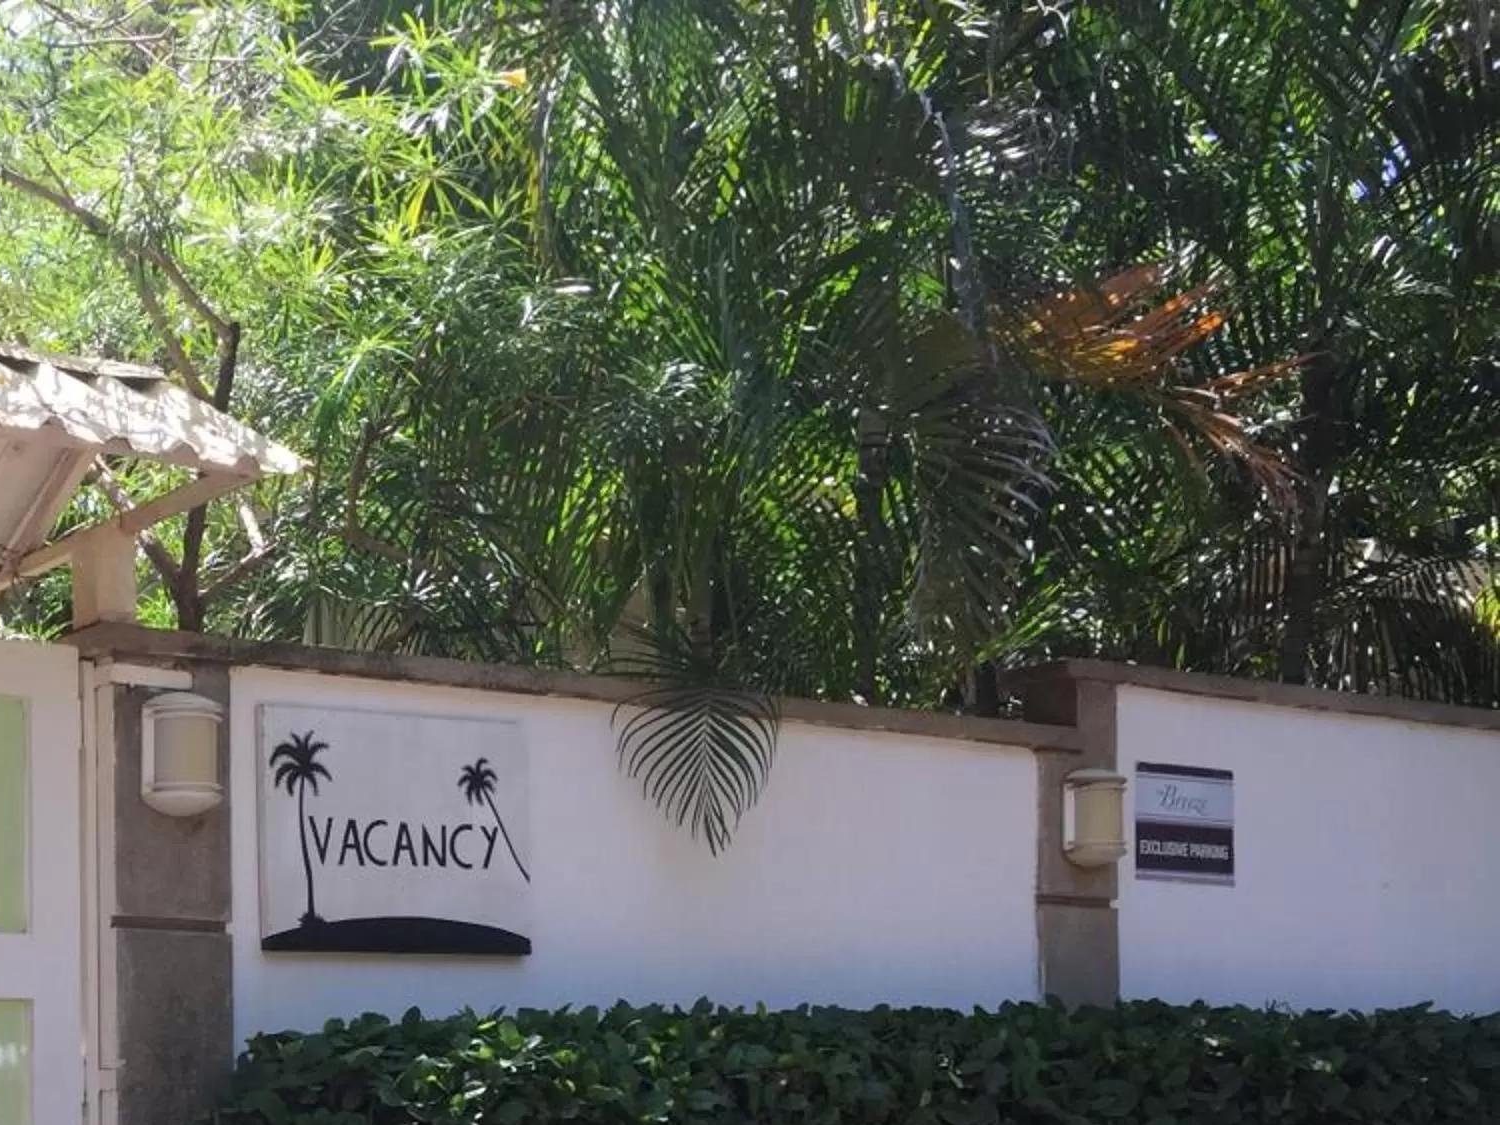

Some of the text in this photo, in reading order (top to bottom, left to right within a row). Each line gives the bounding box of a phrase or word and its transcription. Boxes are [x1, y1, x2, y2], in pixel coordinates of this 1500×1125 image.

[308, 814, 499, 869] VACANCY
[1139, 839, 1229, 860] EXCLUSIVE PARKING
